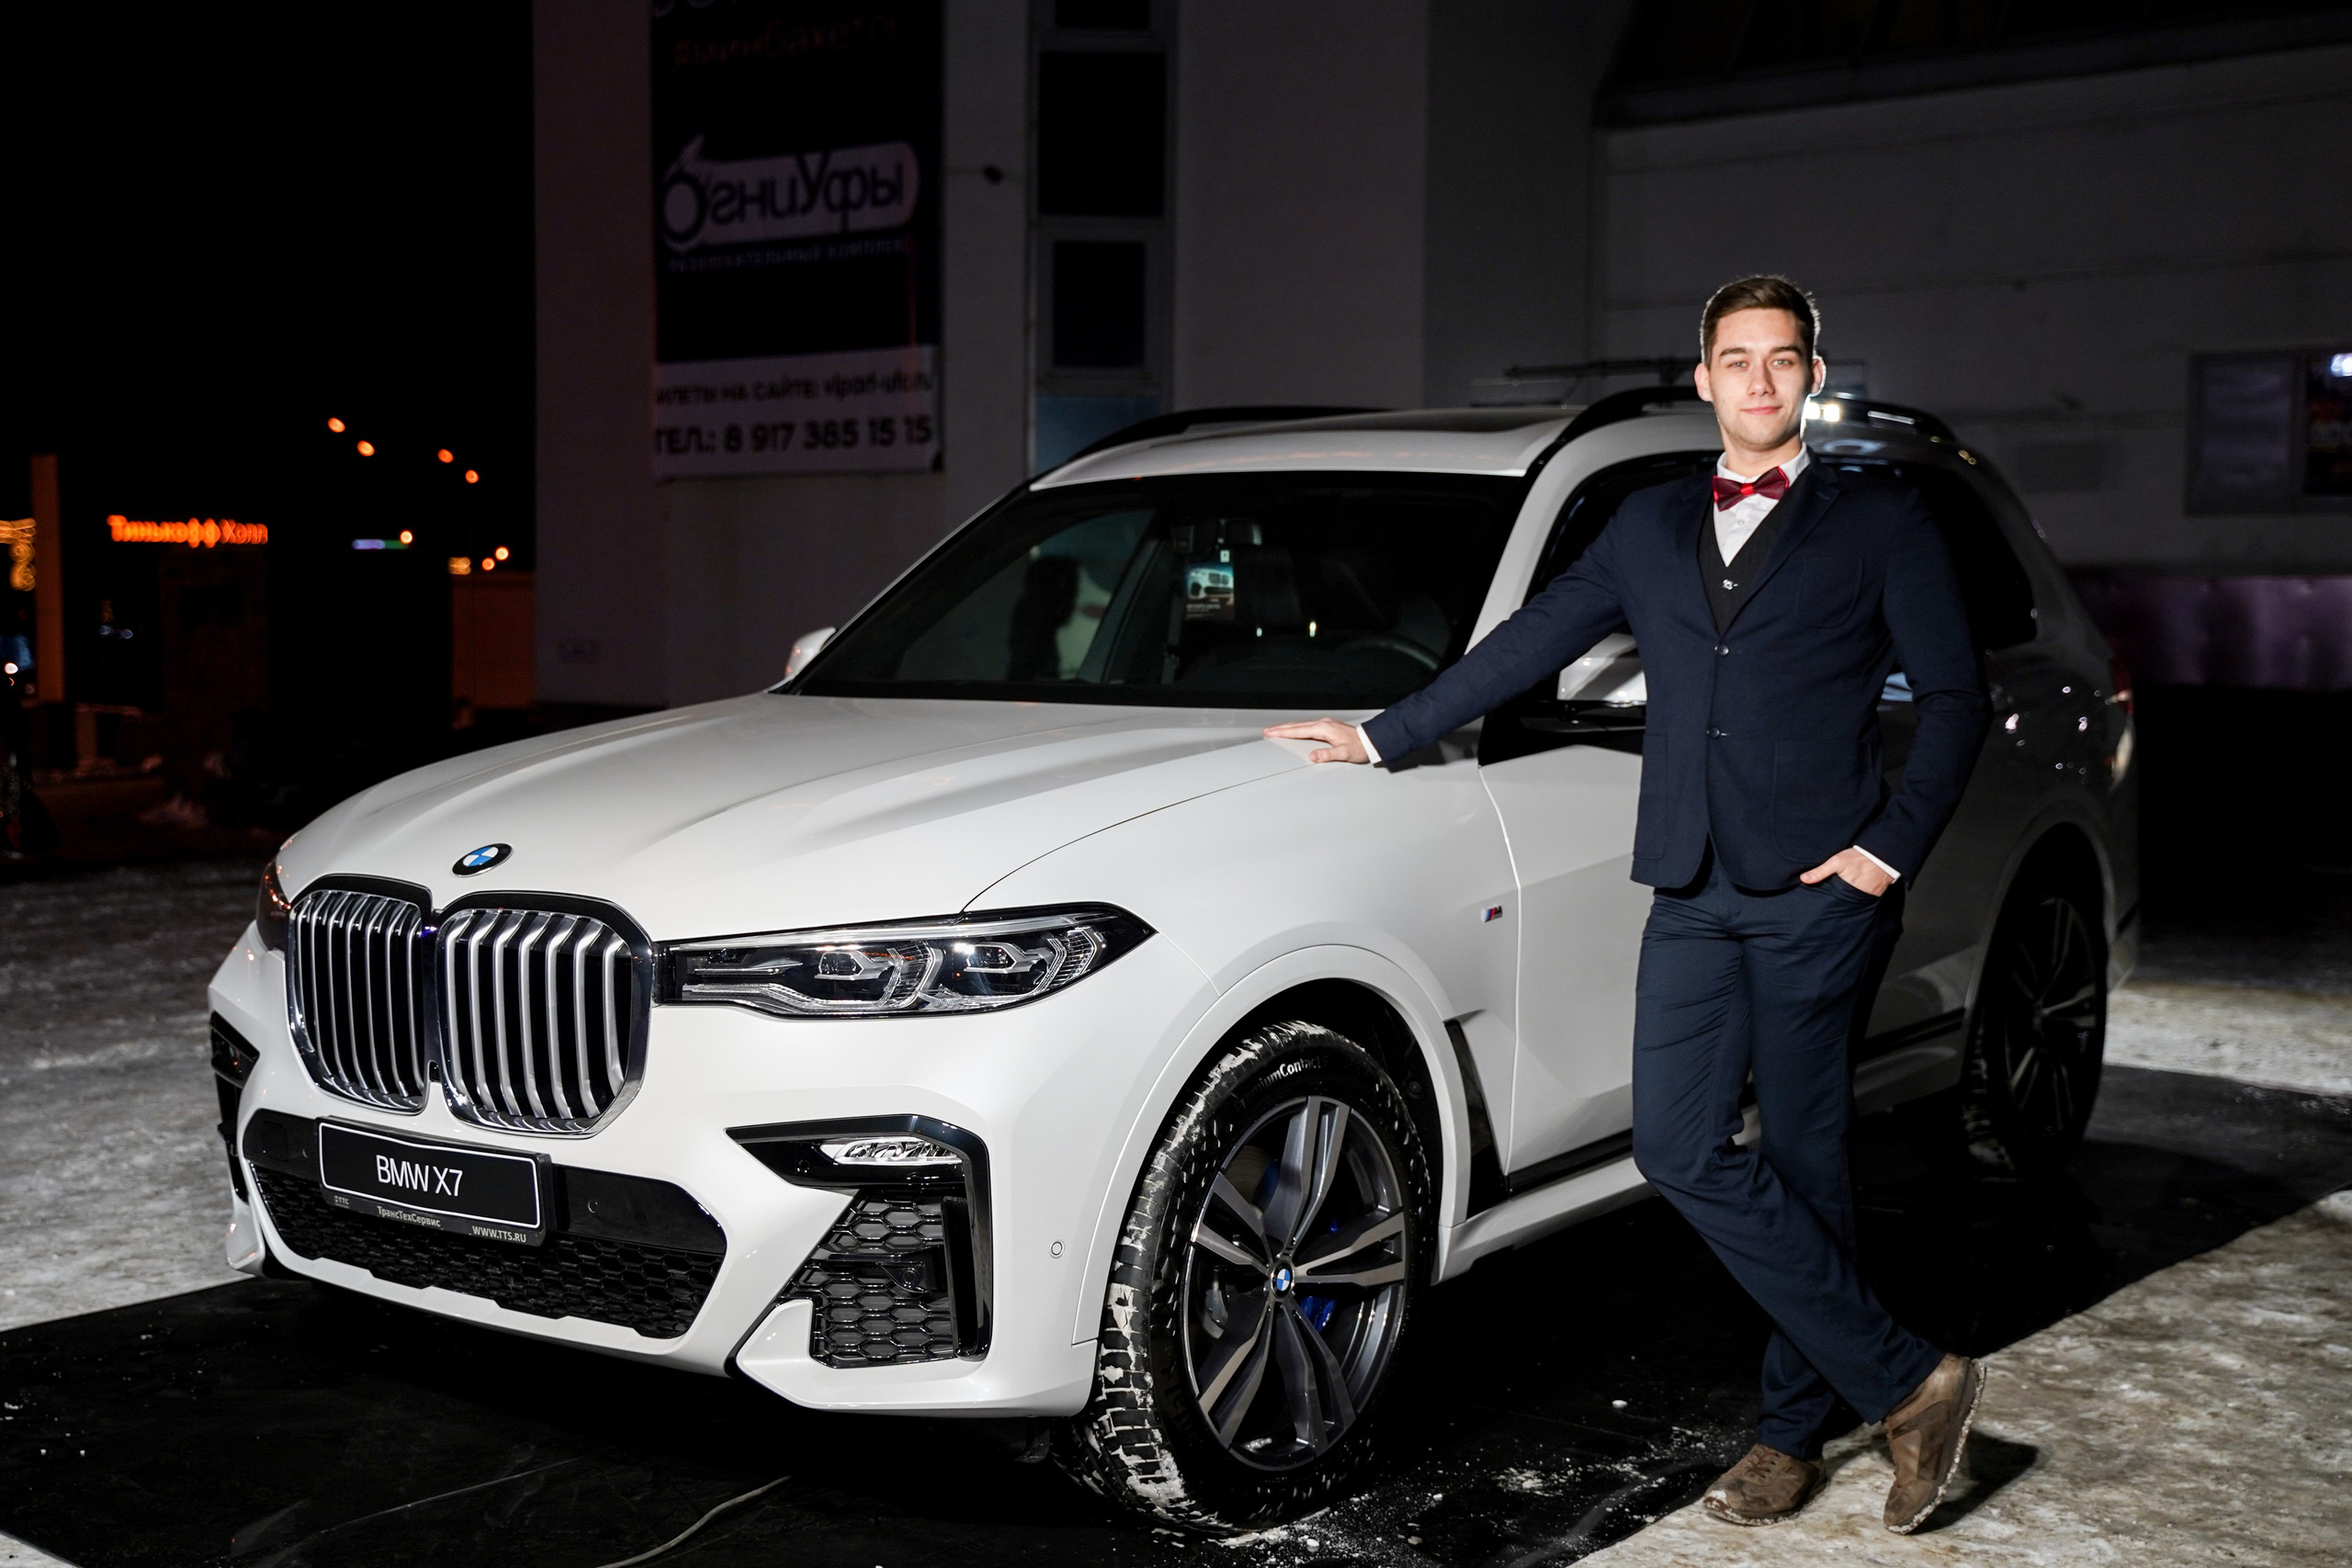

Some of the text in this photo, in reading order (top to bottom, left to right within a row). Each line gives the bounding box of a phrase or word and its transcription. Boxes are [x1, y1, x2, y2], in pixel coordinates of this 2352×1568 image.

[722, 381, 749, 402] НА
[723, 423, 743, 453] 8
[750, 421, 797, 453] 917
[868, 415, 897, 447] 15
[903, 413, 933, 446] 15
[376, 1154, 463, 1197] BMW X7
[377, 1205, 441, 1228] ТрансТехСервис
[471, 1224, 527, 1243] WWW.TTS.RU
